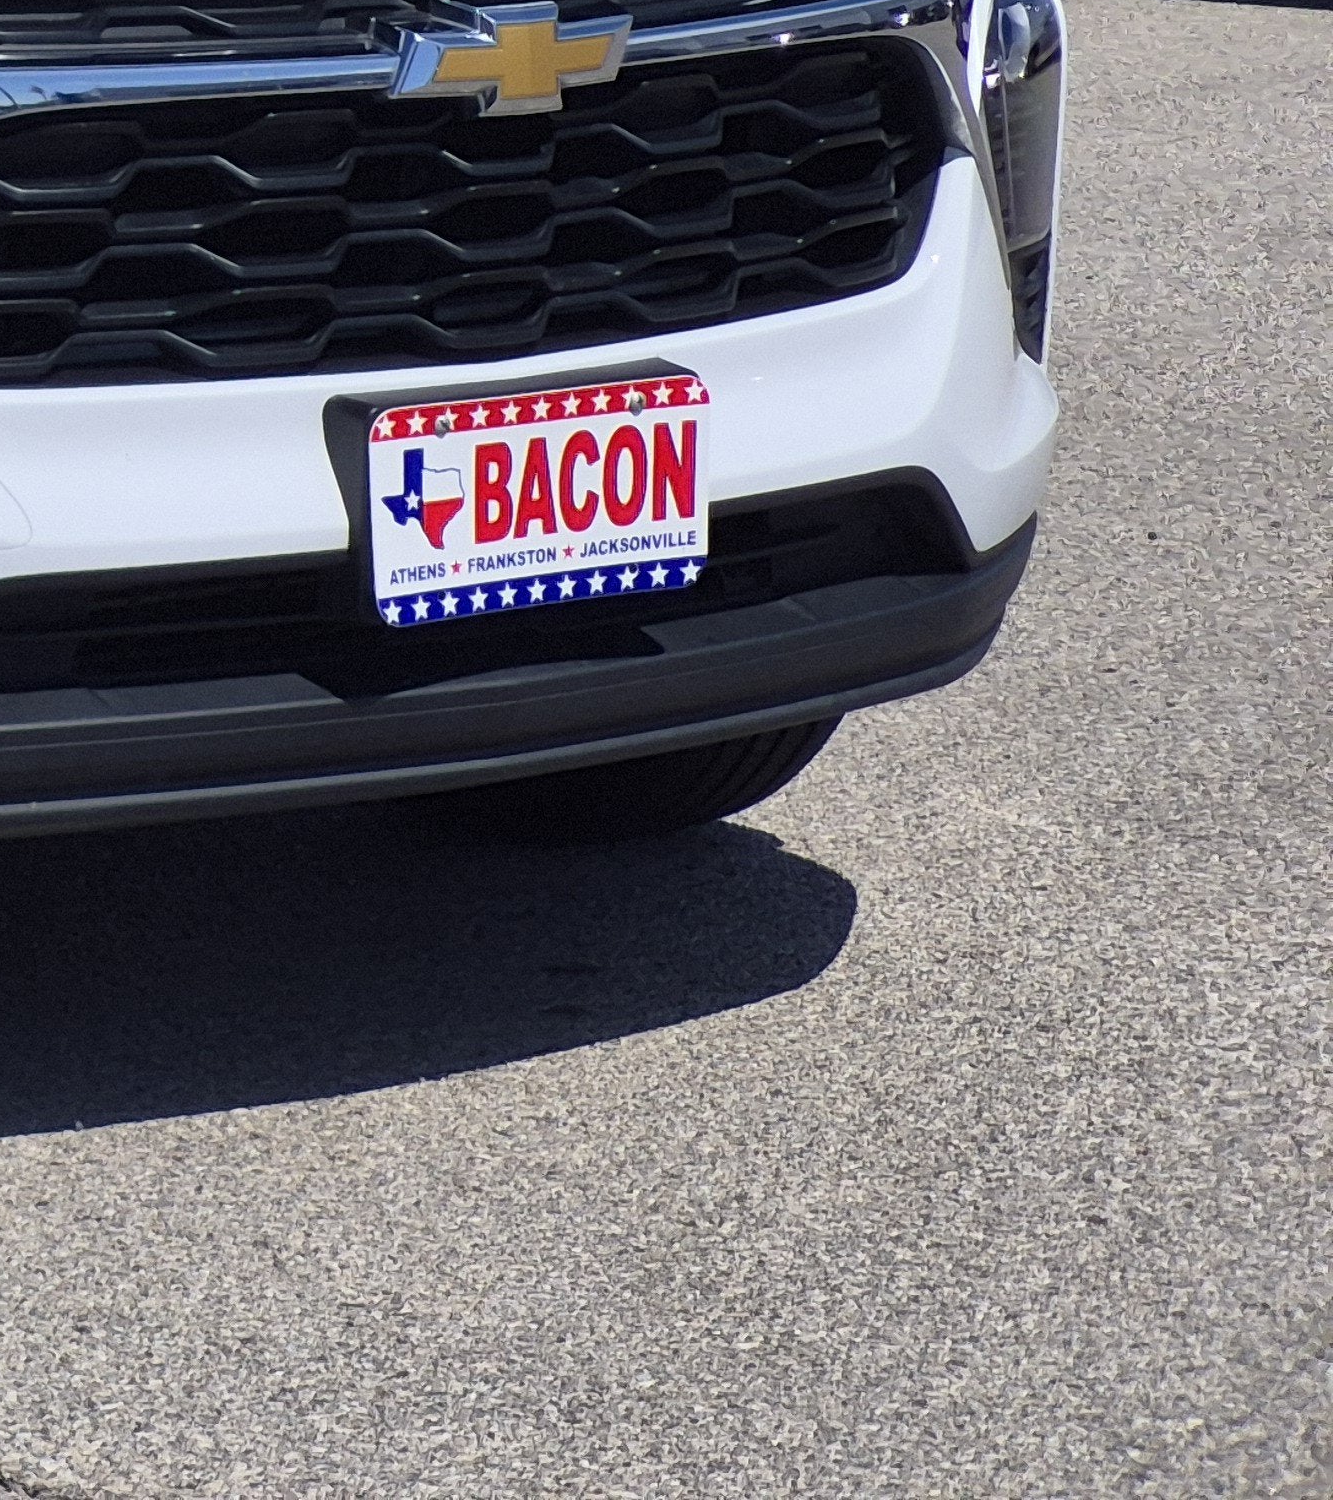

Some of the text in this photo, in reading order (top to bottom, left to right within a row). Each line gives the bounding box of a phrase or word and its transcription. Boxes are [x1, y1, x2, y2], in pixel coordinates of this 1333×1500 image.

[474, 419, 697, 544] BACON
[389, 529, 697, 586] ATHENS FRANKSTON JACKSONVILLE
